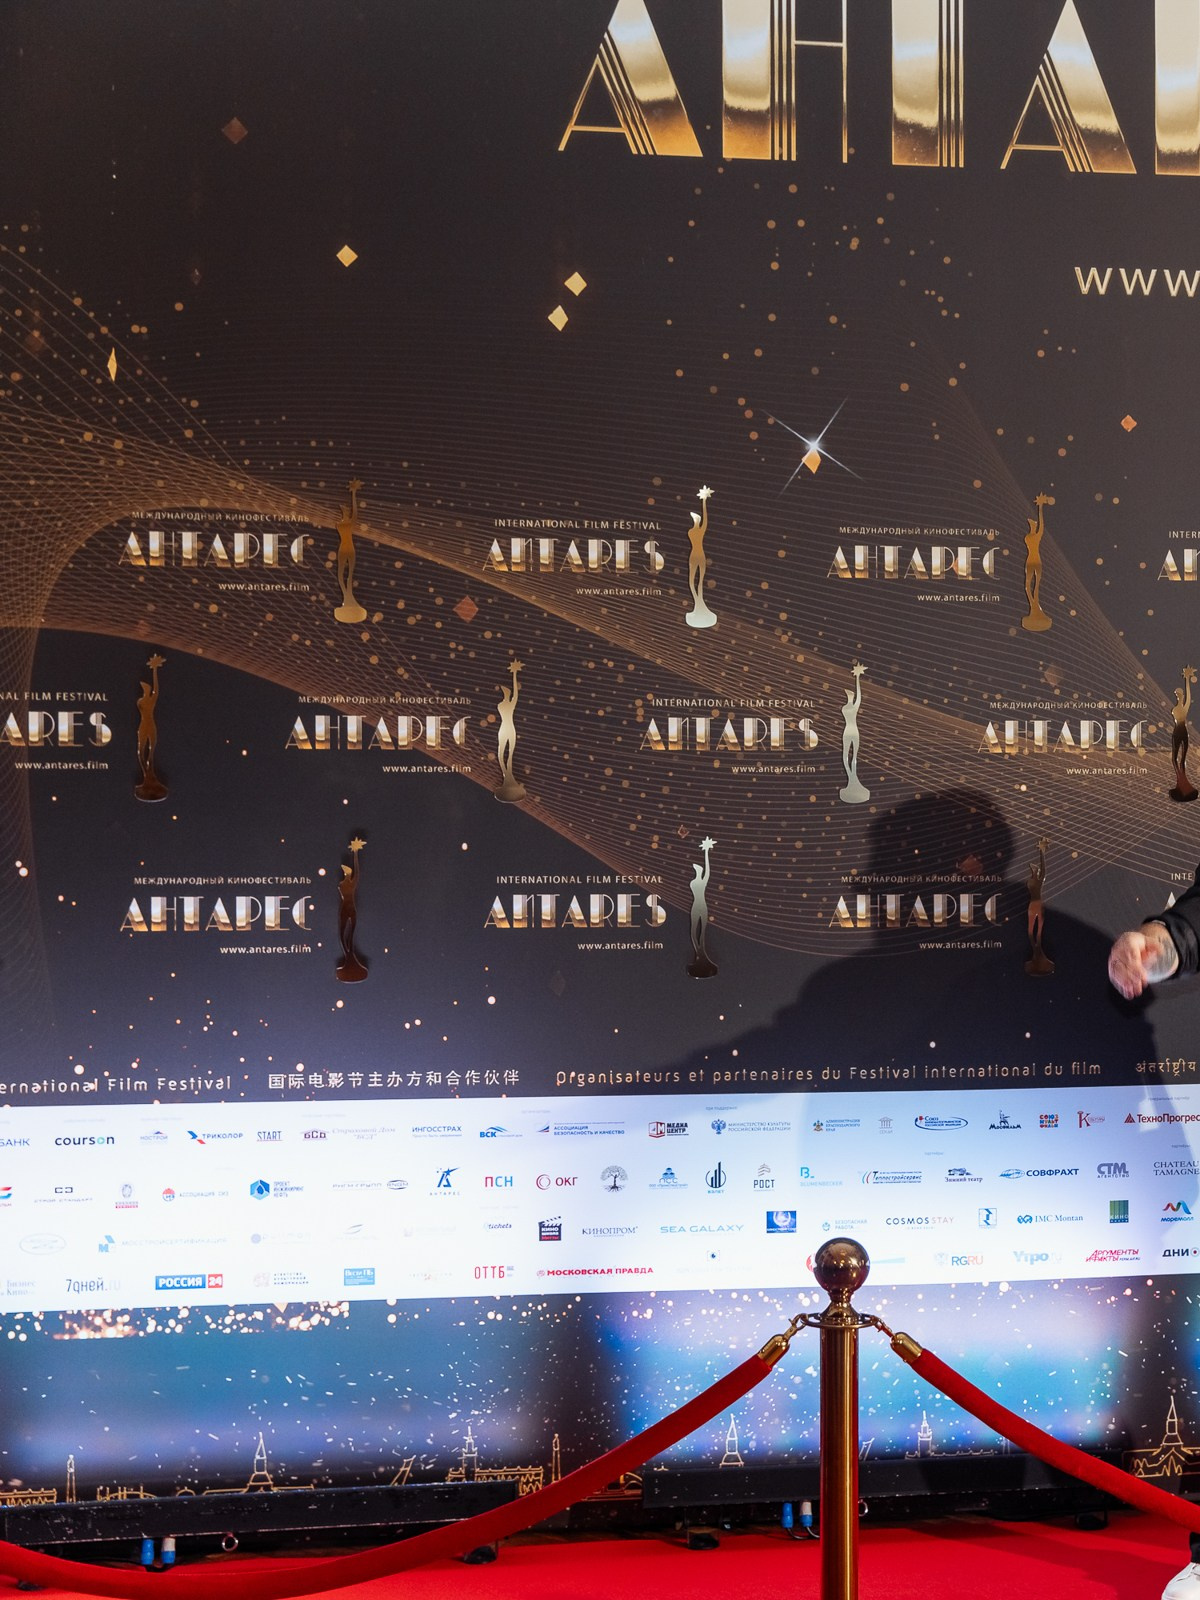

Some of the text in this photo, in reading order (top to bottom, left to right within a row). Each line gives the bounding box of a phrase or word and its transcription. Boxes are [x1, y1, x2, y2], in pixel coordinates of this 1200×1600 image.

[132, 511, 309, 523] МЕЖДУНАРОДНЫЙ КИНОФЕСТИВАЛЬ
[494, 519, 662, 530] INTERNATIONAL FILM FESTIVAL
[839, 526, 1000, 536] МЕЖДУНАРОДНЫЙ КИНОФЕСТИВАЛЬ
[119, 531, 310, 568] АНТАРЕС
[482, 537, 665, 573] ANTARES
[827, 545, 1000, 580] АНТАРЕС
[218, 583, 310, 592] www.antares.film
[576, 587, 662, 596] www.antares.film
[917, 594, 1000, 602] www.antares.film
[24, 692, 51, 700] FILM
[56, 692, 108, 701] FESTIVAL
[299, 695, 472, 705] МЕЖДУНАРОДНЫЙ КИНОФЕСТИВАЛЬ
[652, 698, 815, 708] INTERNATIONAL FILM FESTIVAL
[990, 701, 1148, 710] МЕЖДУНАРОДНЫЙ КИНОФЕСТИВАЛЬ
[285, 715, 472, 750] АНТАРЕС
[639, 717, 819, 751] ANTARES
[978, 720, 1148, 754] АНТАРЕС
[15, 761, 109, 770] www.antares.film
[382, 764, 472, 773] www.antares.film
[731, 765, 816, 773] www.antares.film
[1066, 766, 1148, 775] www.antares.film
[134, 877, 312, 885] МЕЖДУНАРОДНЫЙ КИНОФЕСТИВАЛЬ
[496, 875, 663, 884] INTERNATIONAL FILM FESTIVAL
[841, 874, 1002, 884] МЕЖДУНАРОДНЫЙ КИНОФЕСТИВАЛЬ
[120, 895, 312, 932] АНТАРЕС
[484, 894, 667, 928] ANTARES
[829, 893, 1002, 928] АНТАРЕС
[220, 945, 312, 954] www.antares.film
[578, 941, 664, 950] www.antares.film
[919, 941, 1002, 949] www.antares.film
[556, 1061, 1101, 1087] Organisateurs et partenaires du Festival international du film
[108, 1077, 147, 1092] Film
[158, 1075, 230, 1091] Festival
[268, 1070, 520, 1089] 国际电影节主办方和合作伙伴
[202, 1132, 244, 1140] ТРИКОЛОР
[257, 1131, 282, 1140] START
[55, 1135, 115, 1146] courson
[1153, 1160, 1200, 1169] CHATEAU
[1026, 1168, 1079, 1177] СОВФРАХТ
[1153, 1168, 1200, 1176] TAMAGNE
[485, 1176, 513, 1187] ПСН
[555, 1177, 578, 1186] ОКГ
[753, 1179, 775, 1188] РОСТ
[885, 1217, 930, 1225] COSMOS
[1035, 1214, 1083, 1223] IMC Montan
[660, 1224, 744, 1233] SEA GALAXY
[474, 1266, 505, 1279] ОТТБ
[547, 1267, 654, 1276] МОСКОВСКАЯ ПРАВДА
[159, 1276, 222, 1288] РОССИЯ 24
